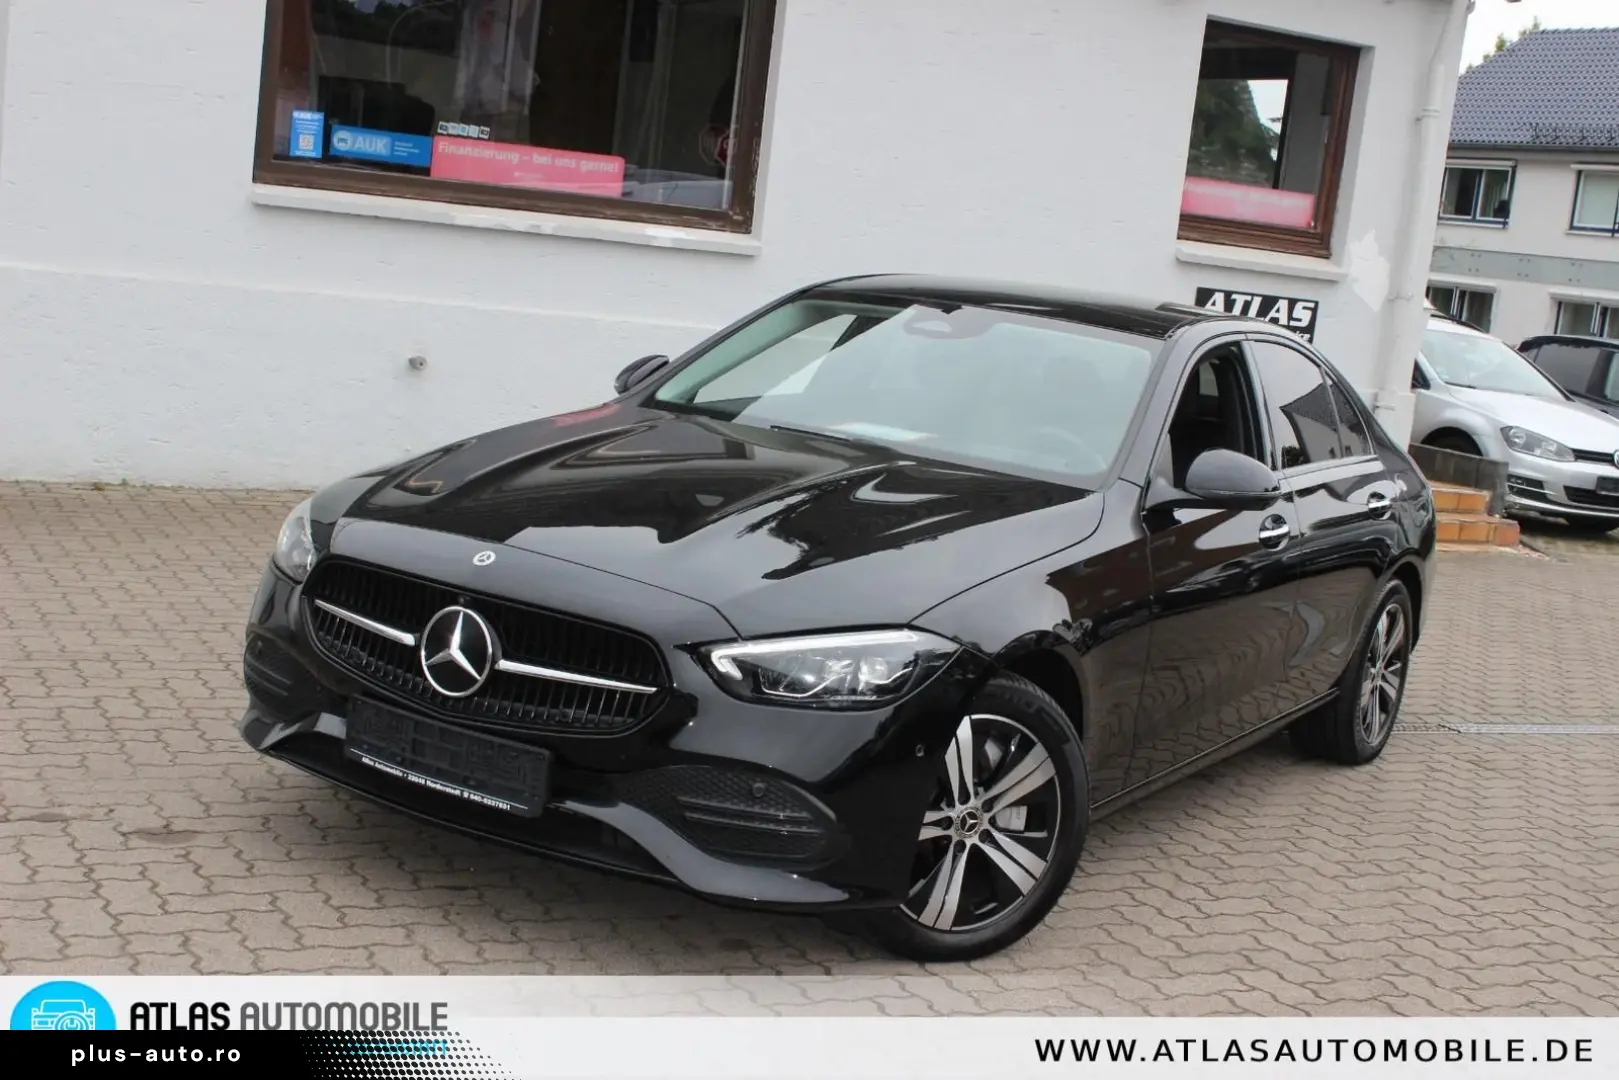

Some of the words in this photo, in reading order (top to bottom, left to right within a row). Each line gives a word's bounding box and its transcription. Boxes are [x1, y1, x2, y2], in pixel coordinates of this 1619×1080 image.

[355, 134, 387, 154] AUK
[438, 142, 520, 164] Finanzierung
[533, 152, 552, 165] bei
[555, 159, 576, 169] uns
[579, 160, 619, 173] gerne!
[1204, 291, 1315, 327] ATLAS
